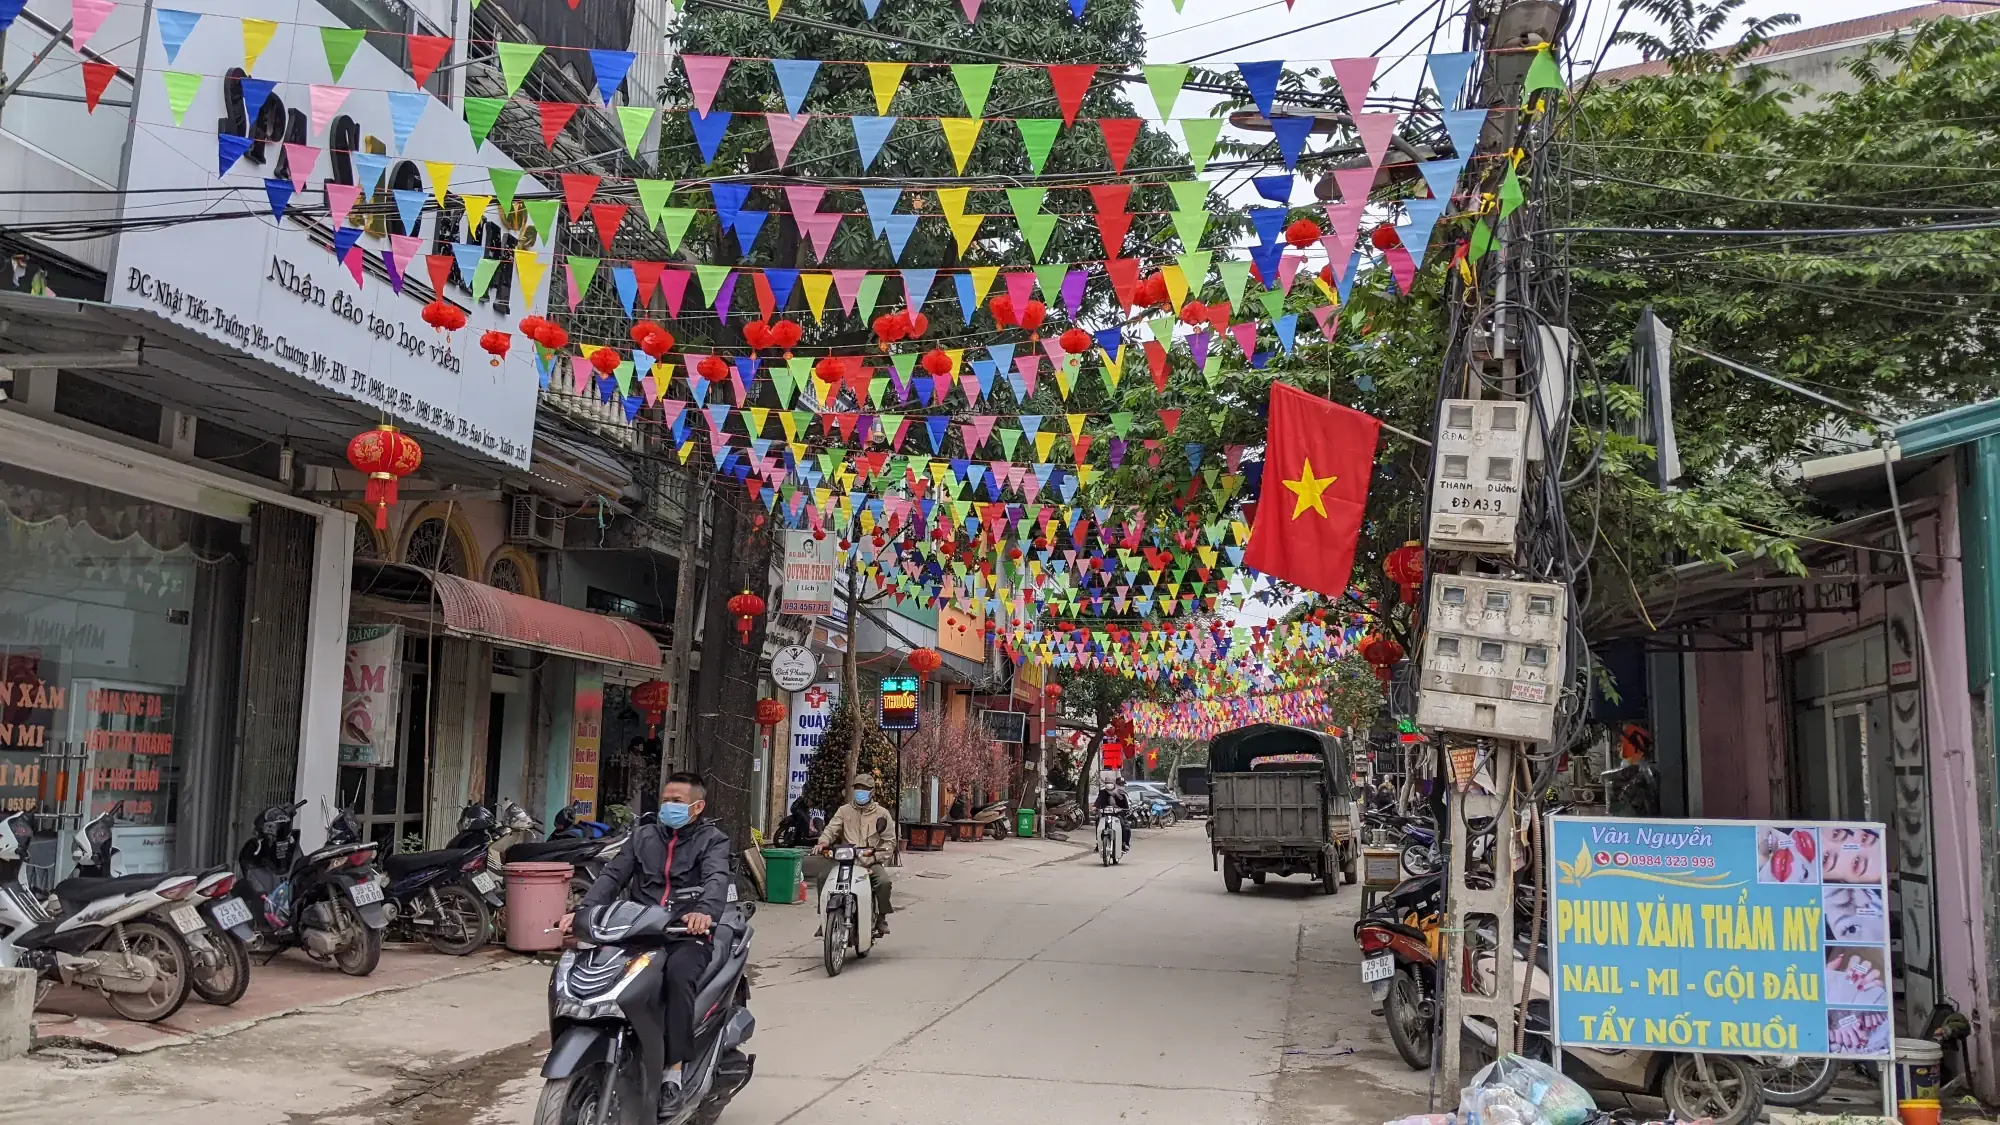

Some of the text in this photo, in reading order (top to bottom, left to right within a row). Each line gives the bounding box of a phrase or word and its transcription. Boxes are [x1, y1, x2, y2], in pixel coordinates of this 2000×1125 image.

[127, 267, 154, 297] ĐC:
[152, 279, 183, 314] Nhật
[266, 255, 326, 307] Nhận
[331, 289, 363, 325] đào
[367, 311, 394, 340] tạo
[397, 322, 426, 357] học
[1440, 481, 1473, 490] THANH
[17, 679, 66, 709] XĂM
[884, 691, 915, 709] THUỐC
[147, 696, 162, 716] DA
[18, 726, 45, 747] MI
[1591, 826, 1712, 849] Vân Nguyễn
[1631, 855, 1661, 867] 0984
[1665, 856, 1688, 867] 323
[1692, 857, 1715, 868] 993
[1557, 888, 1821, 951] PHUN XĂM THẨM MỸ
[1364, 965, 1392, 981] 011.06
[1562, 965, 1622, 993] NAIL
[1647, 968, 1678, 996] MI
[1704, 965, 1754, 1004] GỘI
[1763, 964, 1819, 1001] ĐẦU
[1579, 1005, 1798, 1049] TẨY NỐT RUỒI
